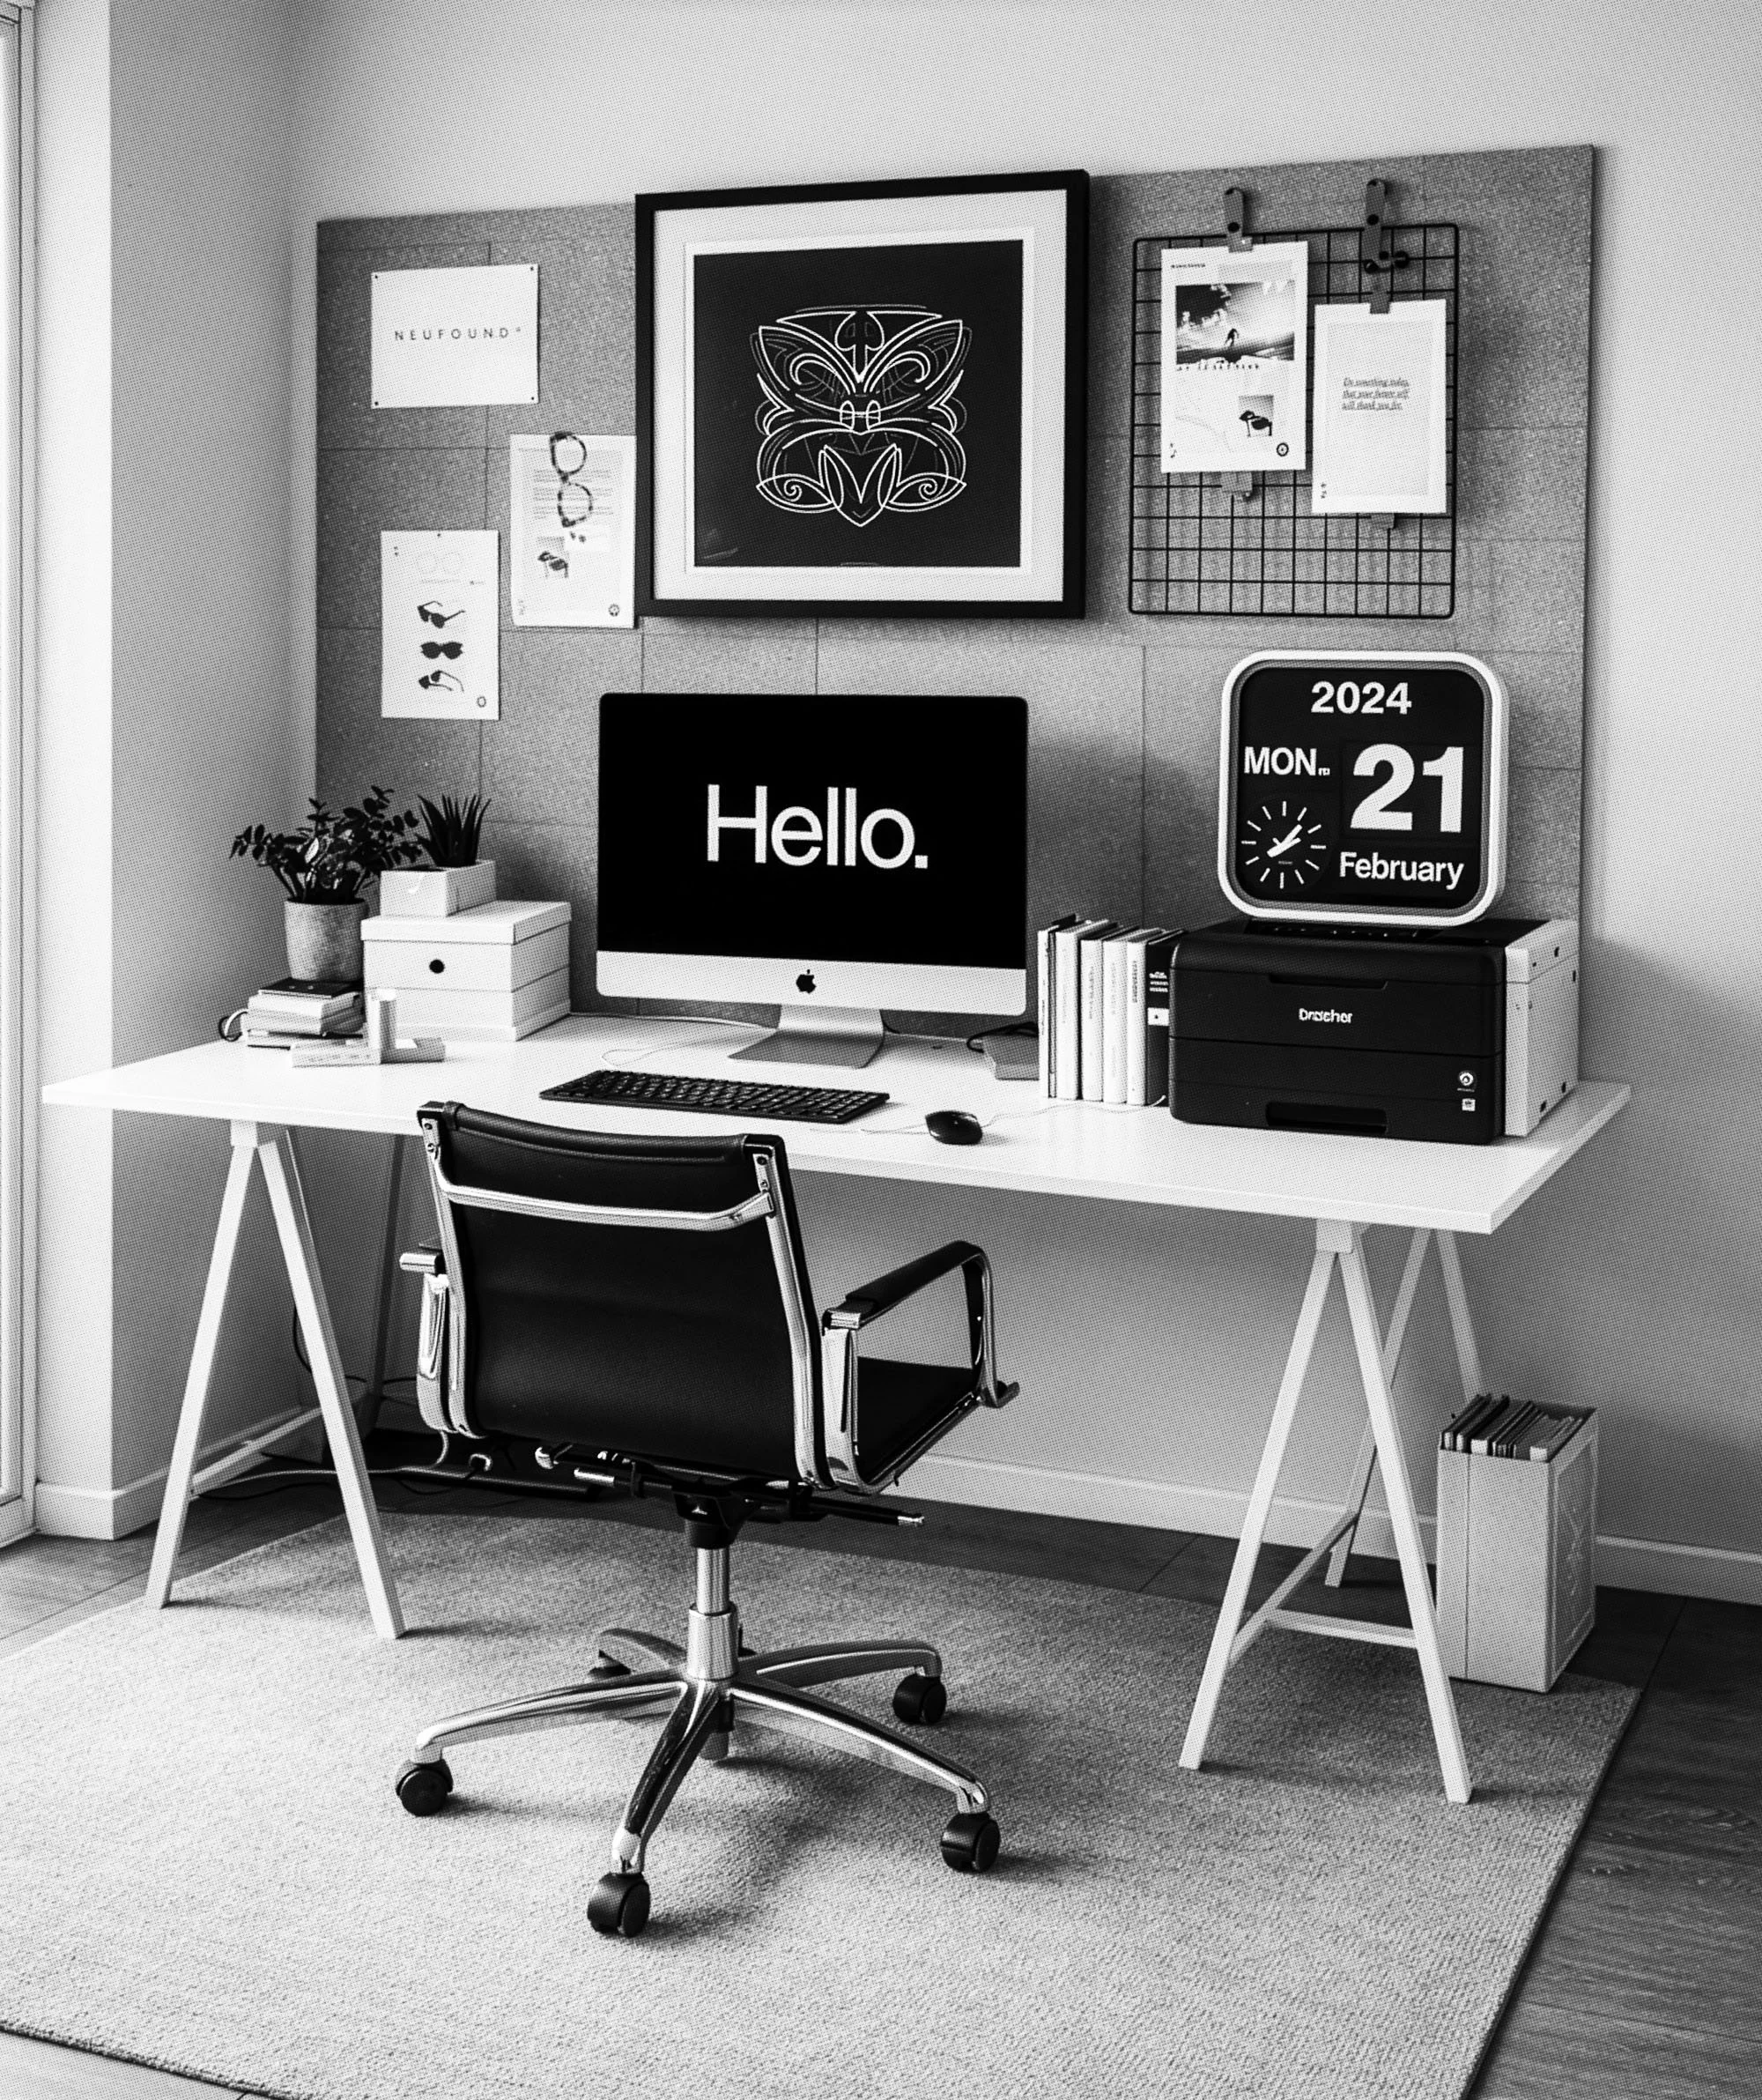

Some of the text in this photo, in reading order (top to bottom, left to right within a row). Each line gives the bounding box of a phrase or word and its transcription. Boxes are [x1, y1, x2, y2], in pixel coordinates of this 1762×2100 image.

[1311, 681, 1412, 715] 2024
[1350, 743, 1464, 833] 21
[707, 783, 929, 869] Hello.
[1340, 851, 1464, 890] February
